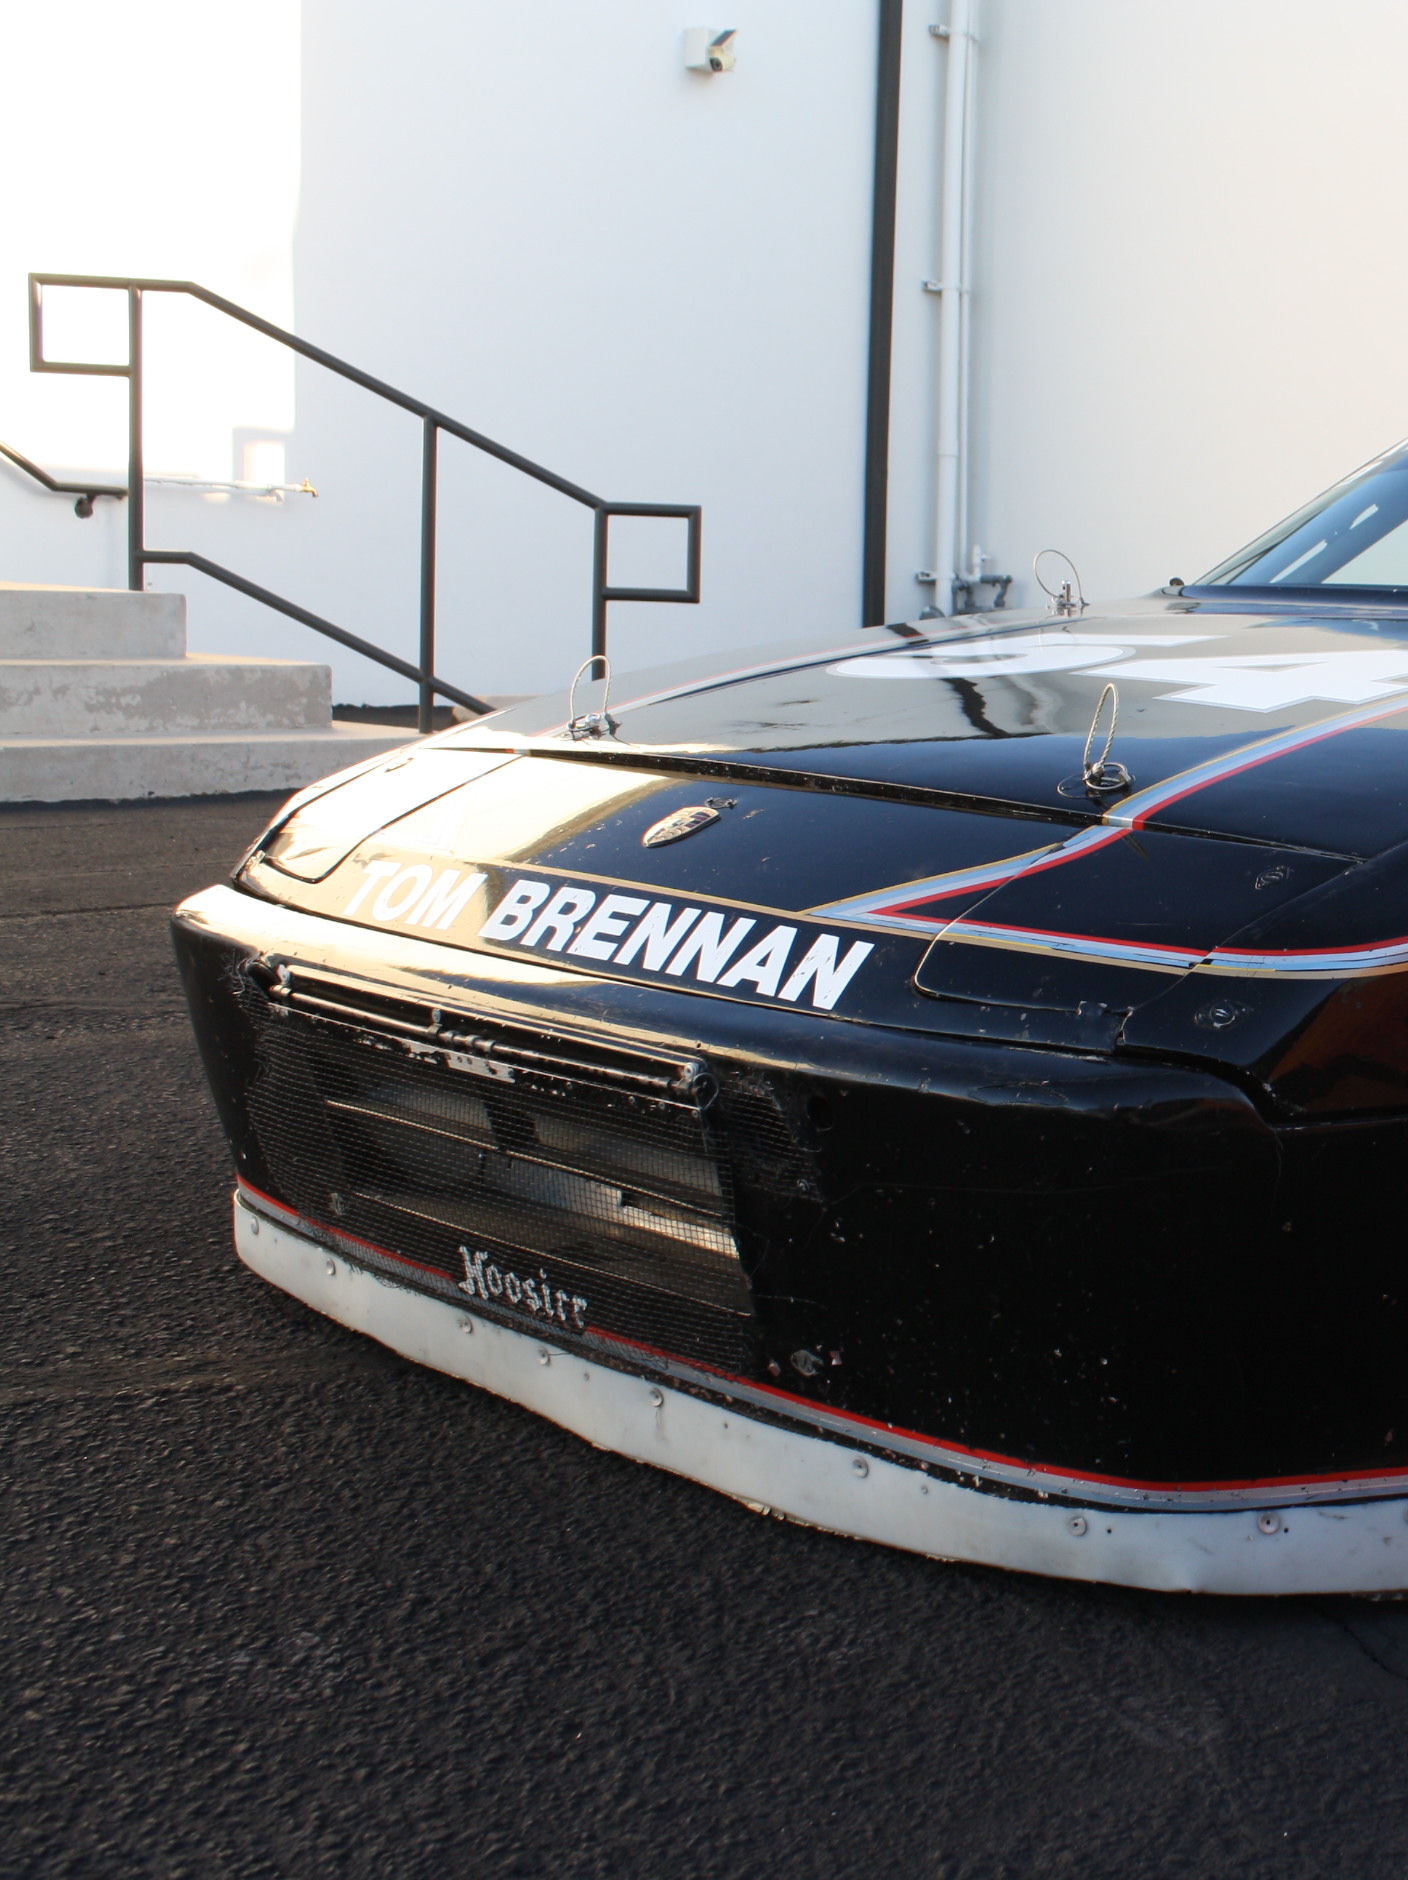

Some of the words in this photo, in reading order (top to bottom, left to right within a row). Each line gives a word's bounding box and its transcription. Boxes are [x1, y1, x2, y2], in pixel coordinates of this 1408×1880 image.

[342, 860, 489, 932] TOM
[478, 879, 876, 1011] BRENNAN
[458, 1244, 588, 1330] Hoosier
